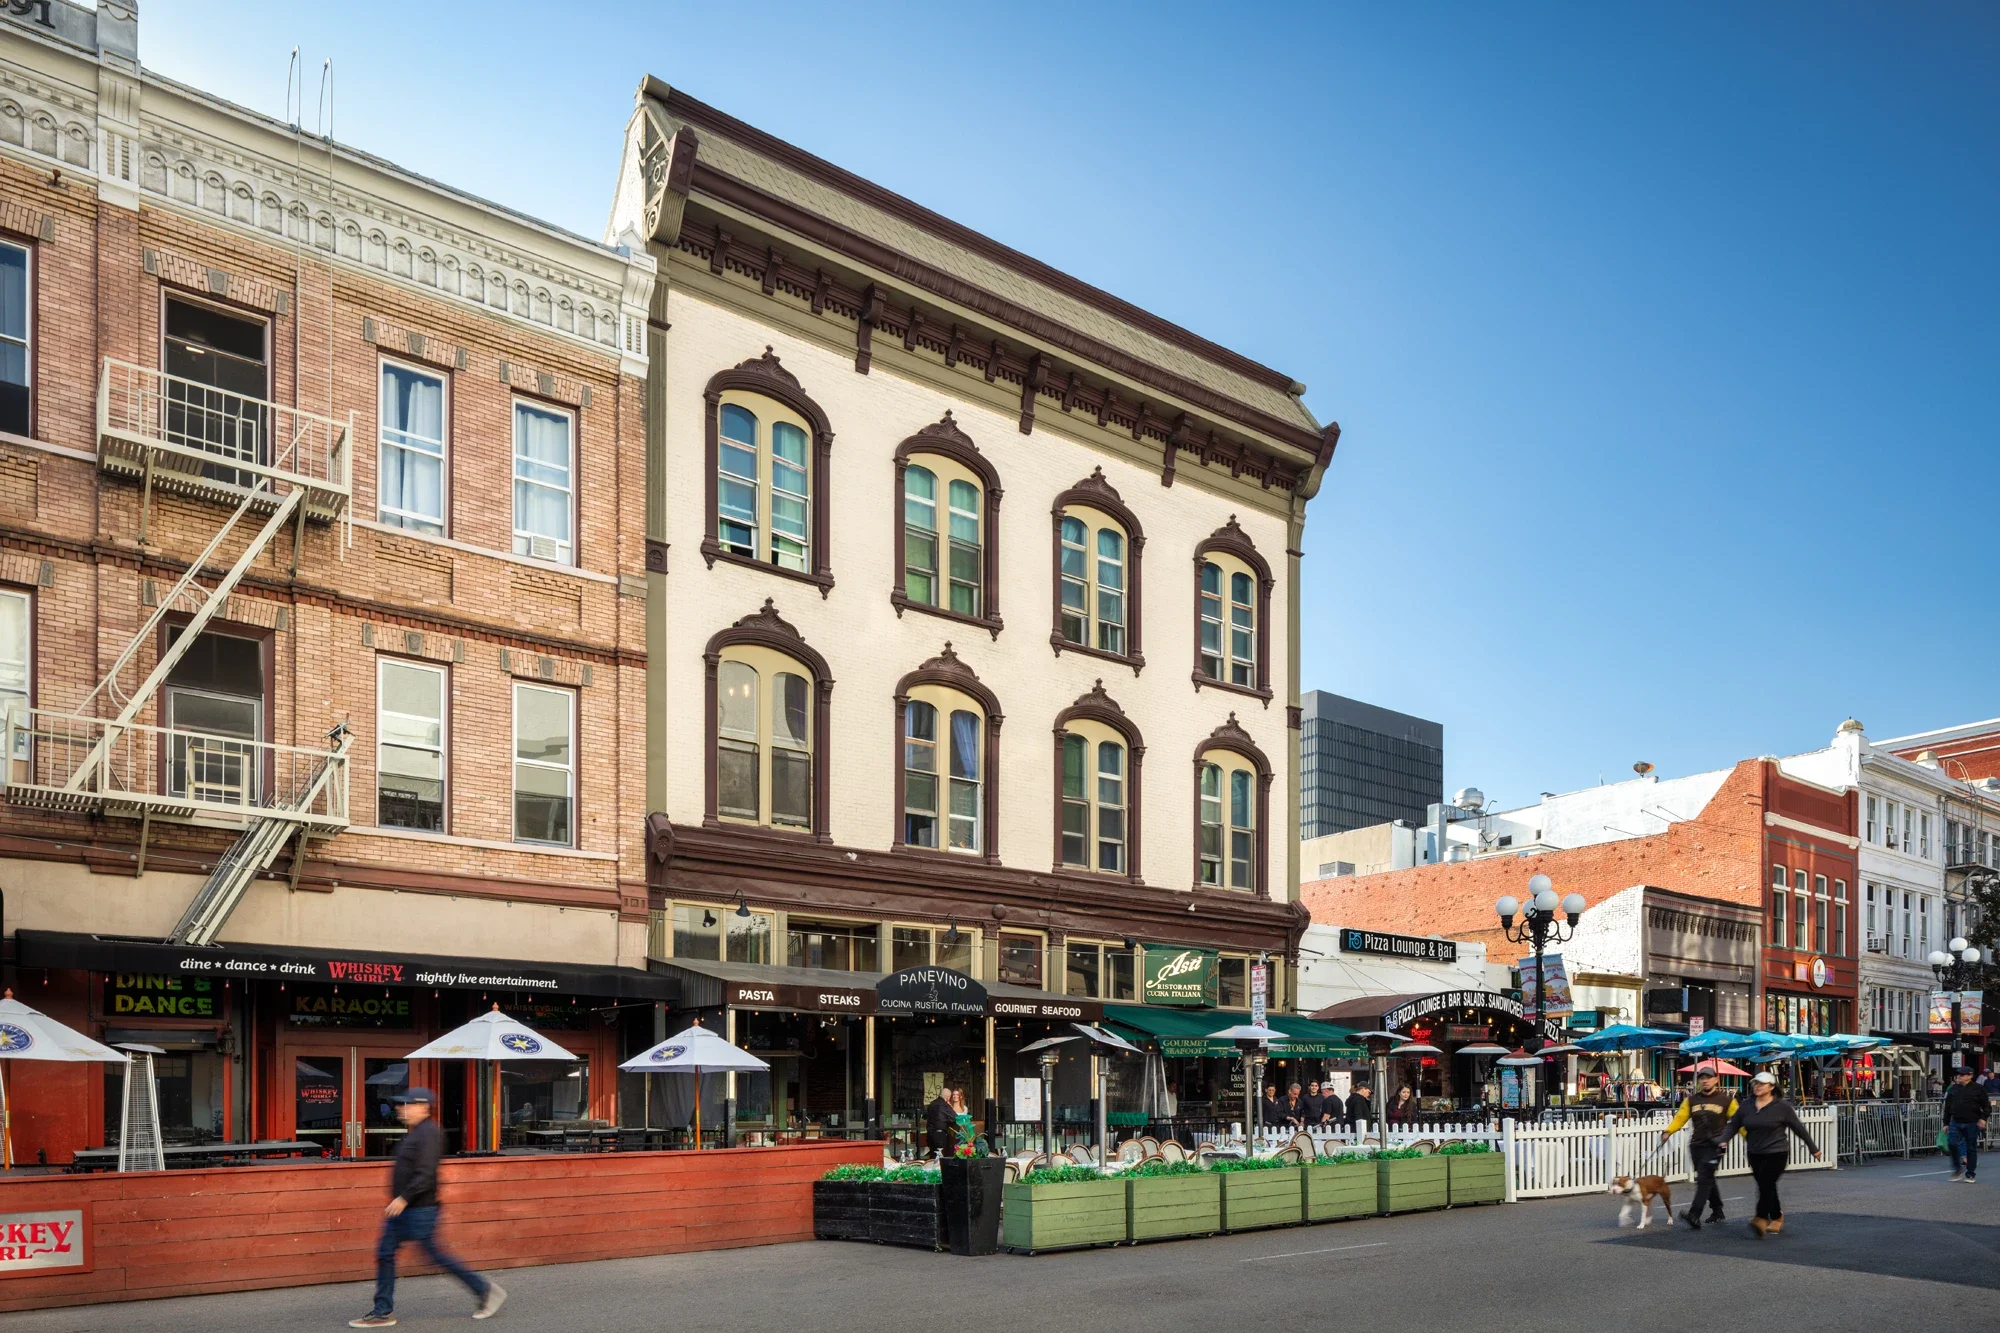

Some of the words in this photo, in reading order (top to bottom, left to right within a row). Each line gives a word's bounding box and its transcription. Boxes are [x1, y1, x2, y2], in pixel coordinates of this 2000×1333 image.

[0, 0, 56, 29] 91
[1365, 934, 1389, 951] Pizza
[1392, 938, 1426, 957] Lounge
[1428, 941, 1436, 957] &
[1438, 943, 1453, 958] Bar
[180, 958, 212, 970] dine
[225, 959, 268, 972] dance
[279, 962, 316, 975] drink
[328, 961, 404, 983] WHISKEY
[1146, 951, 1203, 989] Asti
[354, 973, 385, 983] GIRL
[416, 971, 456, 986] nightly
[458, 972, 478, 984] live
[478, 975, 558, 990] entertainment.
[900, 970, 967, 990] PANEVINO
[739, 990, 775, 1001] PASTA
[819, 994, 861, 1006] STEAKS
[1147, 990, 1169, 998] CUCINA
[115, 994, 213, 1015] DANCE
[881, 999, 912, 1009] CUCINA
[914, 1001, 948, 1010] RUSTICA
[951, 1003, 984, 1012] ITALIANA
[995, 1003, 1038, 1015] GOURMET
[1041, 1006, 1081, 1017] SEAFOOD
[1398, 1004, 1417, 1026] PIZZA
[1417, 998, 1441, 1016] LOUNGE
[1441, 995, 1446, 1009] &
[1448, 993, 1461, 1007] BAR
[1488, 994, 1524, 1019] SANDWICHES
[1544, 1019, 1560, 1044] PIZZA
[1166, 1047, 1207, 1055] SEAFOOD
